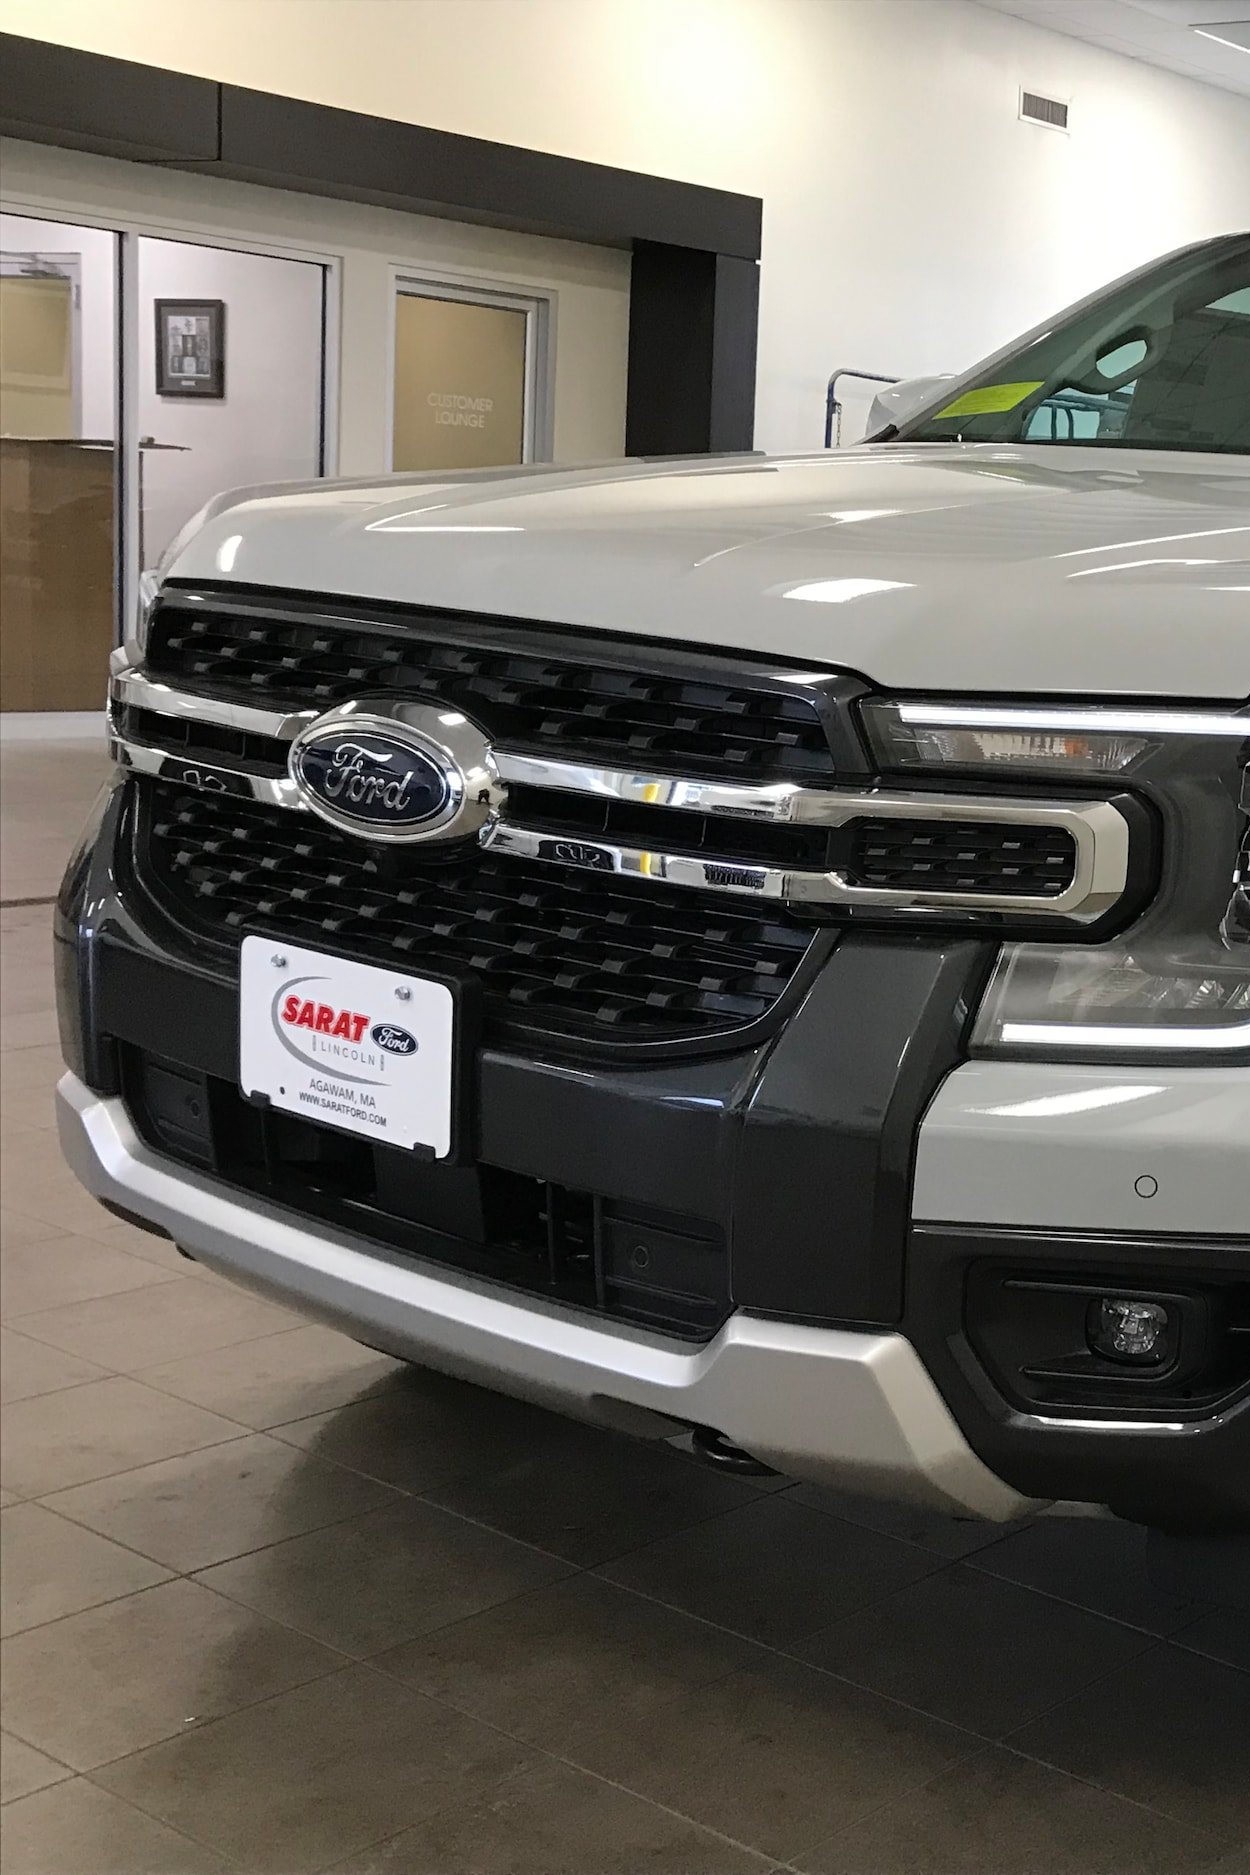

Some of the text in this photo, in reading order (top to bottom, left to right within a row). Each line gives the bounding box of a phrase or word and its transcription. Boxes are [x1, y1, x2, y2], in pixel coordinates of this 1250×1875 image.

[428, 393, 493, 411] CUSTOMER
[436, 411, 485, 428] LOUNGE
[325, 744, 414, 810] Ford
[282, 994, 371, 1043] SARAT
[378, 1027, 410, 1052] Ford
[321, 1042, 375, 1065] LINCOLN
[309, 1079, 376, 1108] AGAWAM, MA
[299, 1091, 387, 1127] WWW.SARATFORD.COM
